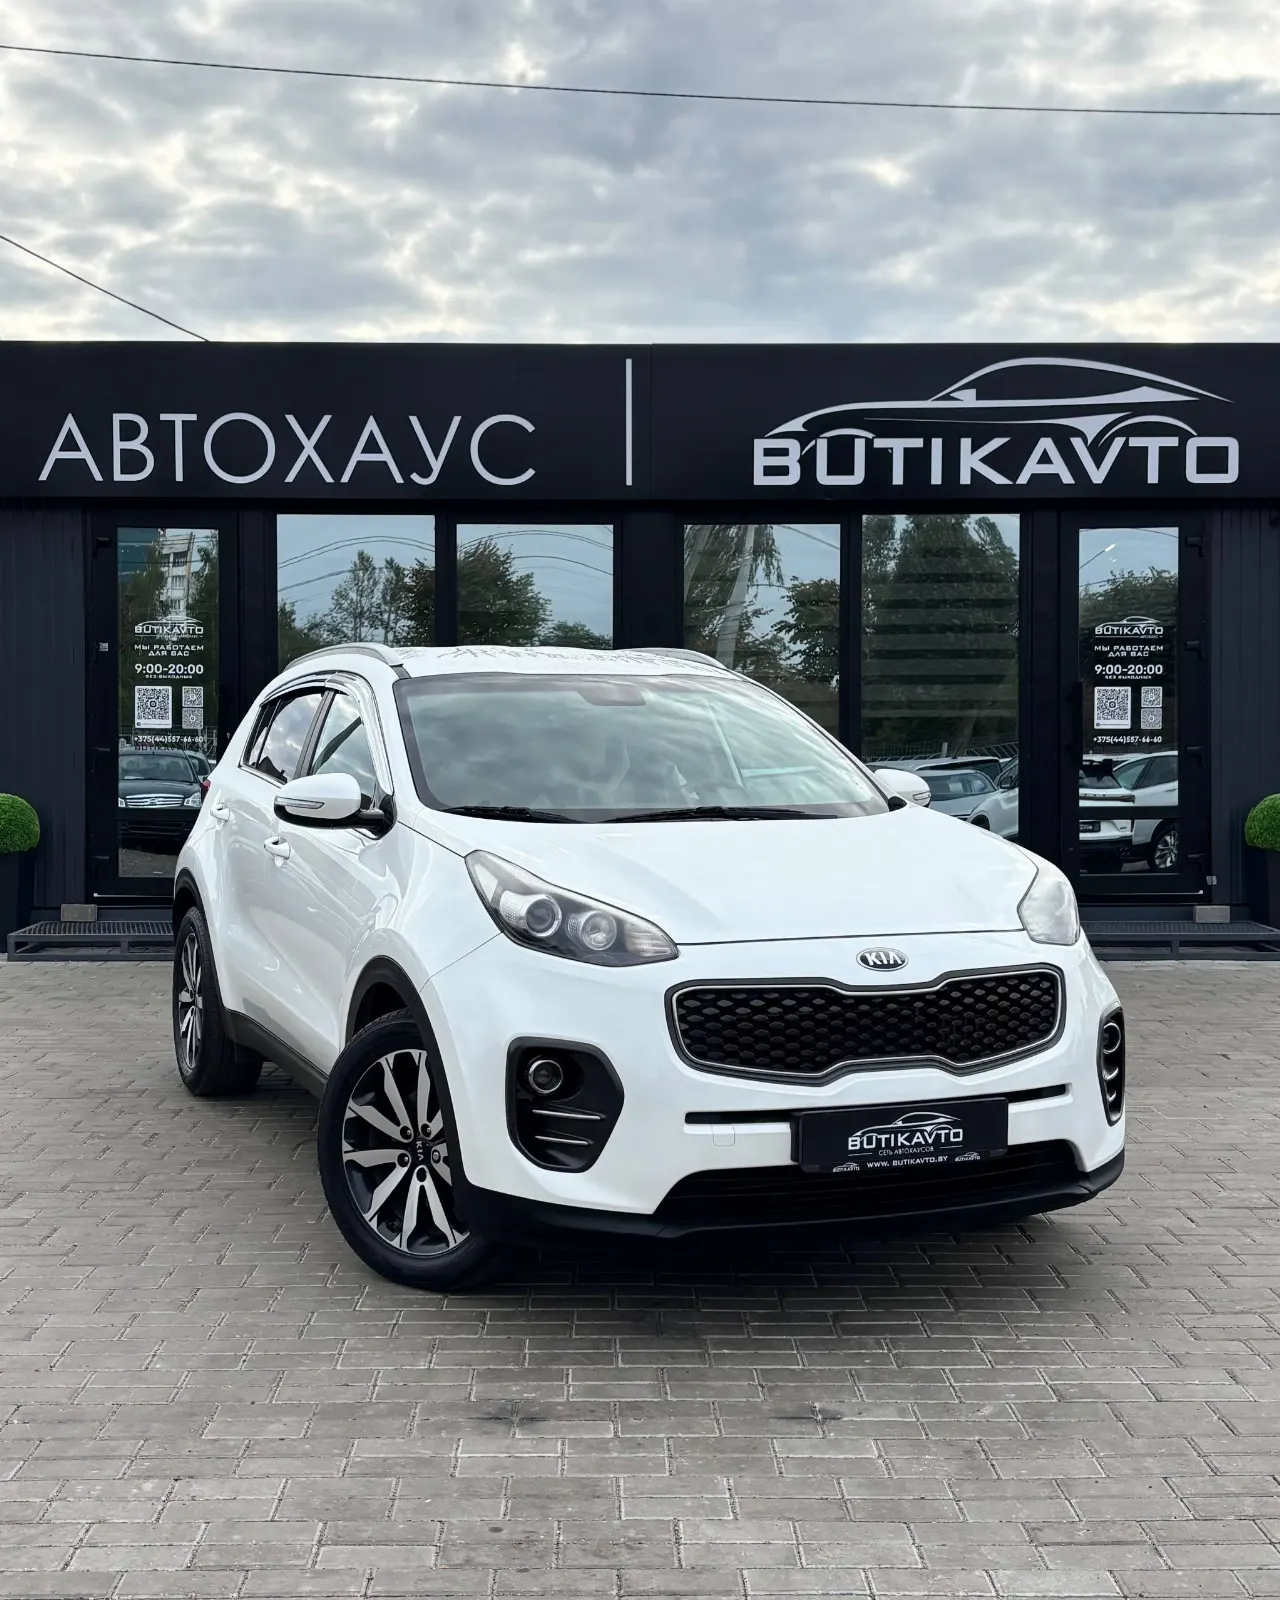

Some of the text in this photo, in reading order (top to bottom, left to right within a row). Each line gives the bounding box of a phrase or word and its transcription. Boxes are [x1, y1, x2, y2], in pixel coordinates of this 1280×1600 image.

[38, 411, 536, 486] АВТОХАУС
[753, 436, 1239, 486] BUTIKAVTO
[134, 625, 204, 634] BUTIKAVTO
[1094, 626, 1164, 635] BUTIKAVTO
[135, 664, 203, 674] 9:00-20:00
[1094, 664, 1163, 675] 9:00-20:00
[1093, 736, 1162, 744] +375(44)557-66-60
[864, 951, 903, 966] KIA
[848, 1129, 963, 1150] BUTIKAVTO
[416, 1141, 424, 1161] KIA
[878, 1146, 934, 1156] СЕТЬ АВТОХАУСОВ
[866, 1155, 949, 1168] WWW. BUTIKAVTO.BY
